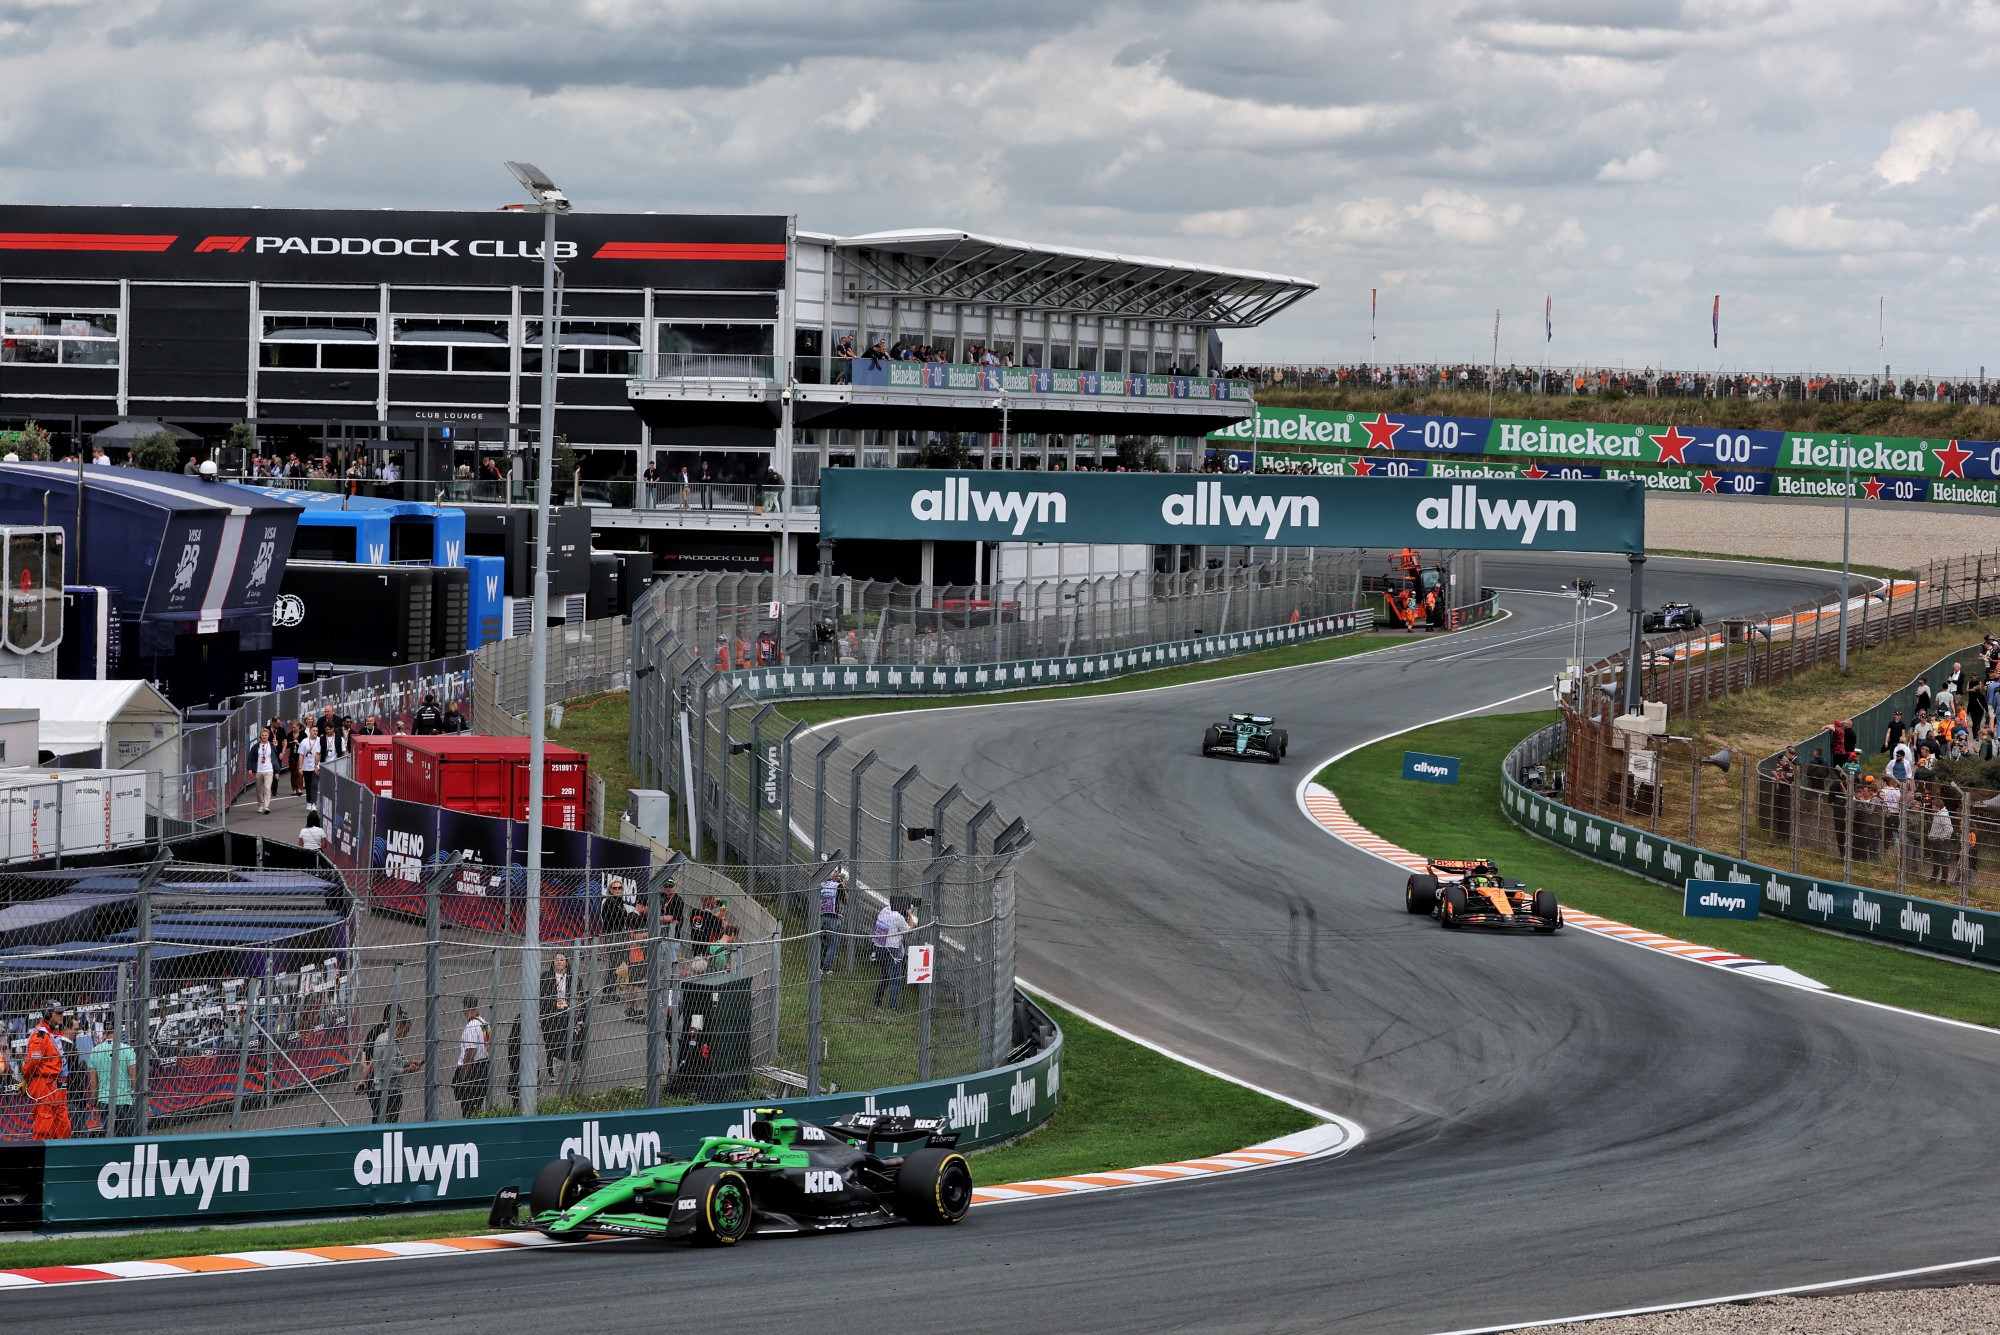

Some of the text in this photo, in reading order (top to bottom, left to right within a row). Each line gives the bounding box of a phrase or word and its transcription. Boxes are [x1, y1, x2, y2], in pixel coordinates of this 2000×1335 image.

[255, 236, 460, 256] PADDOCK
[469, 240, 578, 258] CLUB
[444, 412, 483, 420] LOUNGE
[1424, 421, 1458, 449] 0.0
[1499, 424, 1641, 457] Heineken
[1716, 434, 1750, 463] 0.0
[1790, 437, 1925, 472] Heineken
[1734, 475, 1755, 493] 0.0
[1778, 476, 1856, 497] Heineken
[1895, 481, 1914, 499] 0.0
[1933, 483, 1998, 504] Heineken
[911, 477, 1577, 544] allwyn allwyn allwyn
[188, 529, 202, 542] VISA
[264, 527, 276, 540] VISA
[369, 543, 384, 565] W
[446, 540, 459, 568] W
[486, 575, 498, 603] W
[765, 746, 780, 804] allwyn
[1414, 762, 1448, 776] allwyn
[386, 829, 409, 854] LIKE
[409, 834, 424, 858] NO
[385, 853, 422, 884] OTHER
[1635, 834, 1653, 870] allwyn
[1663, 844, 1682, 879] allwyn
[1766, 874, 1791, 912] allwyn
[1807, 883, 1834, 922] allwyn
[1852, 891, 1881, 932] allwyn
[1900, 901, 1931, 942] allwyn
[1951, 911, 1984, 953] allwyn
[1699, 893, 1746, 911] allwyn
[857, 1116, 877, 1126] KIC
[913, 1118, 938, 1129] KICK
[98, 1144, 250, 1210] allwyn
[354, 1131, 479, 1196] allwyn
[948, 1083, 989, 1138] allwyn
[1010, 1070, 1036, 1122] allwyn
[803, 1127, 826, 1141] KICK
[804, 1170, 844, 1194] KICK
[678, 1198, 697, 1211] KICK
